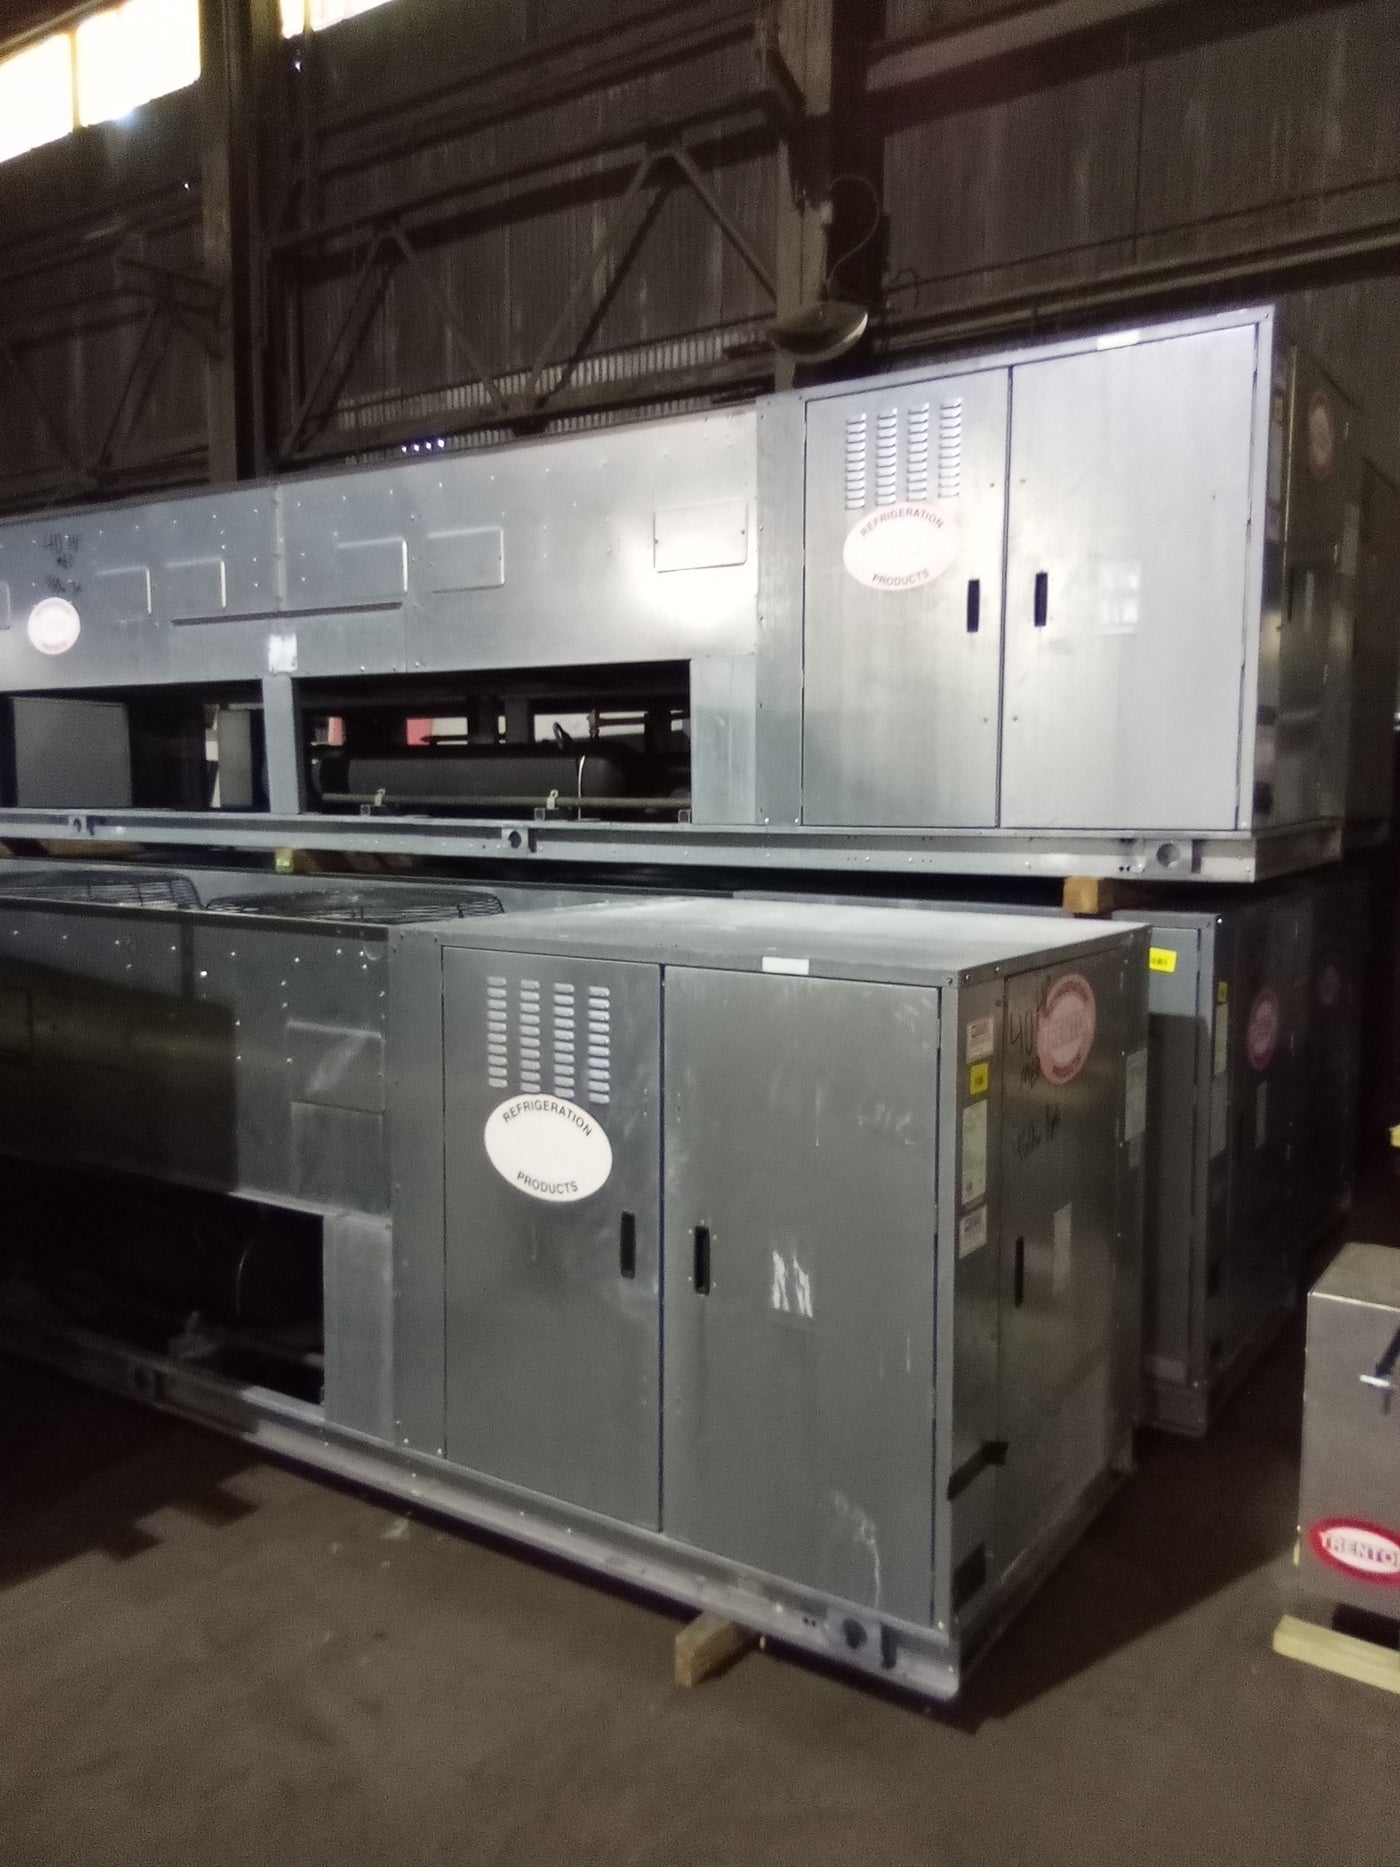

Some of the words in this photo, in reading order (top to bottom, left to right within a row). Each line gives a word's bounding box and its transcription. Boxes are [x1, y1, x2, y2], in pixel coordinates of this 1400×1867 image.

[860, 509, 944, 536] REFRIGERATION
[873, 569, 929, 586] PRODUCTS
[502, 1100, 592, 1136] REFRIGERATION
[517, 1172, 578, 1194] PRODUCTS
